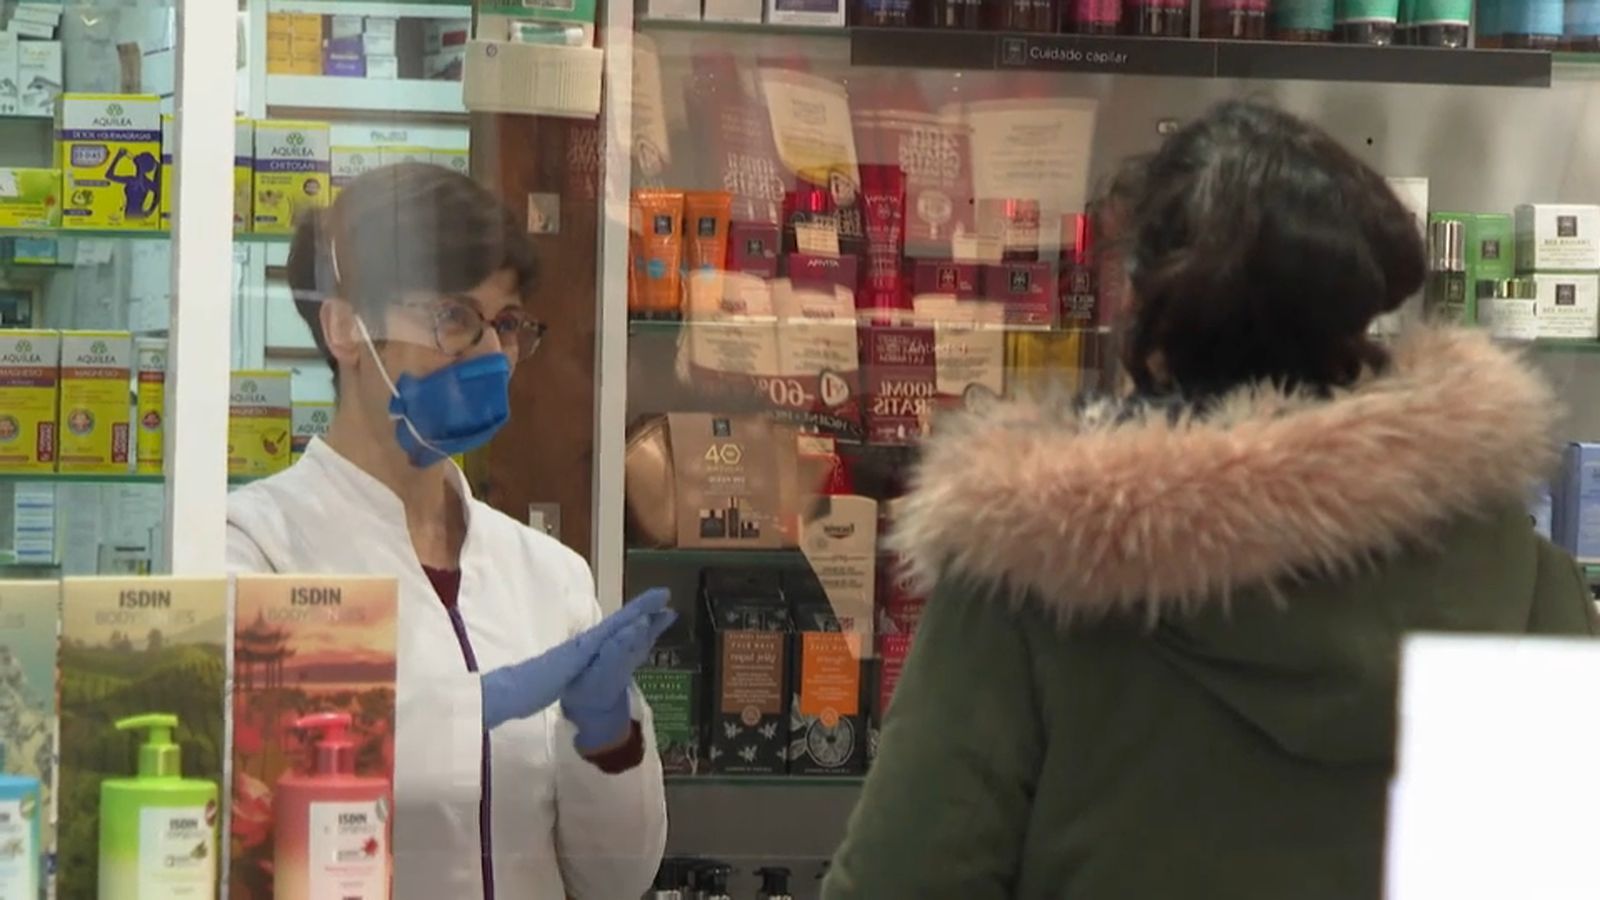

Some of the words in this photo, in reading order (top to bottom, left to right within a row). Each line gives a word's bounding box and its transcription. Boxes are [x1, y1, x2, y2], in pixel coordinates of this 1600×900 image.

[1029, 46, 1082, 61] Cuidado
[1085, 51, 1128, 64] capilar
[93, 117, 133, 127] AQUILEA
[271, 146, 315, 156] AQUILEA
[269, 161, 316, 171] CHITOSAN
[2, 354, 42, 364] AQUILEA
[76, 354, 117, 364] AQUILEA
[704, 443, 742, 465] 40
[119, 590, 171, 608] ISDIN
[290, 587, 342, 606] ISDIN
